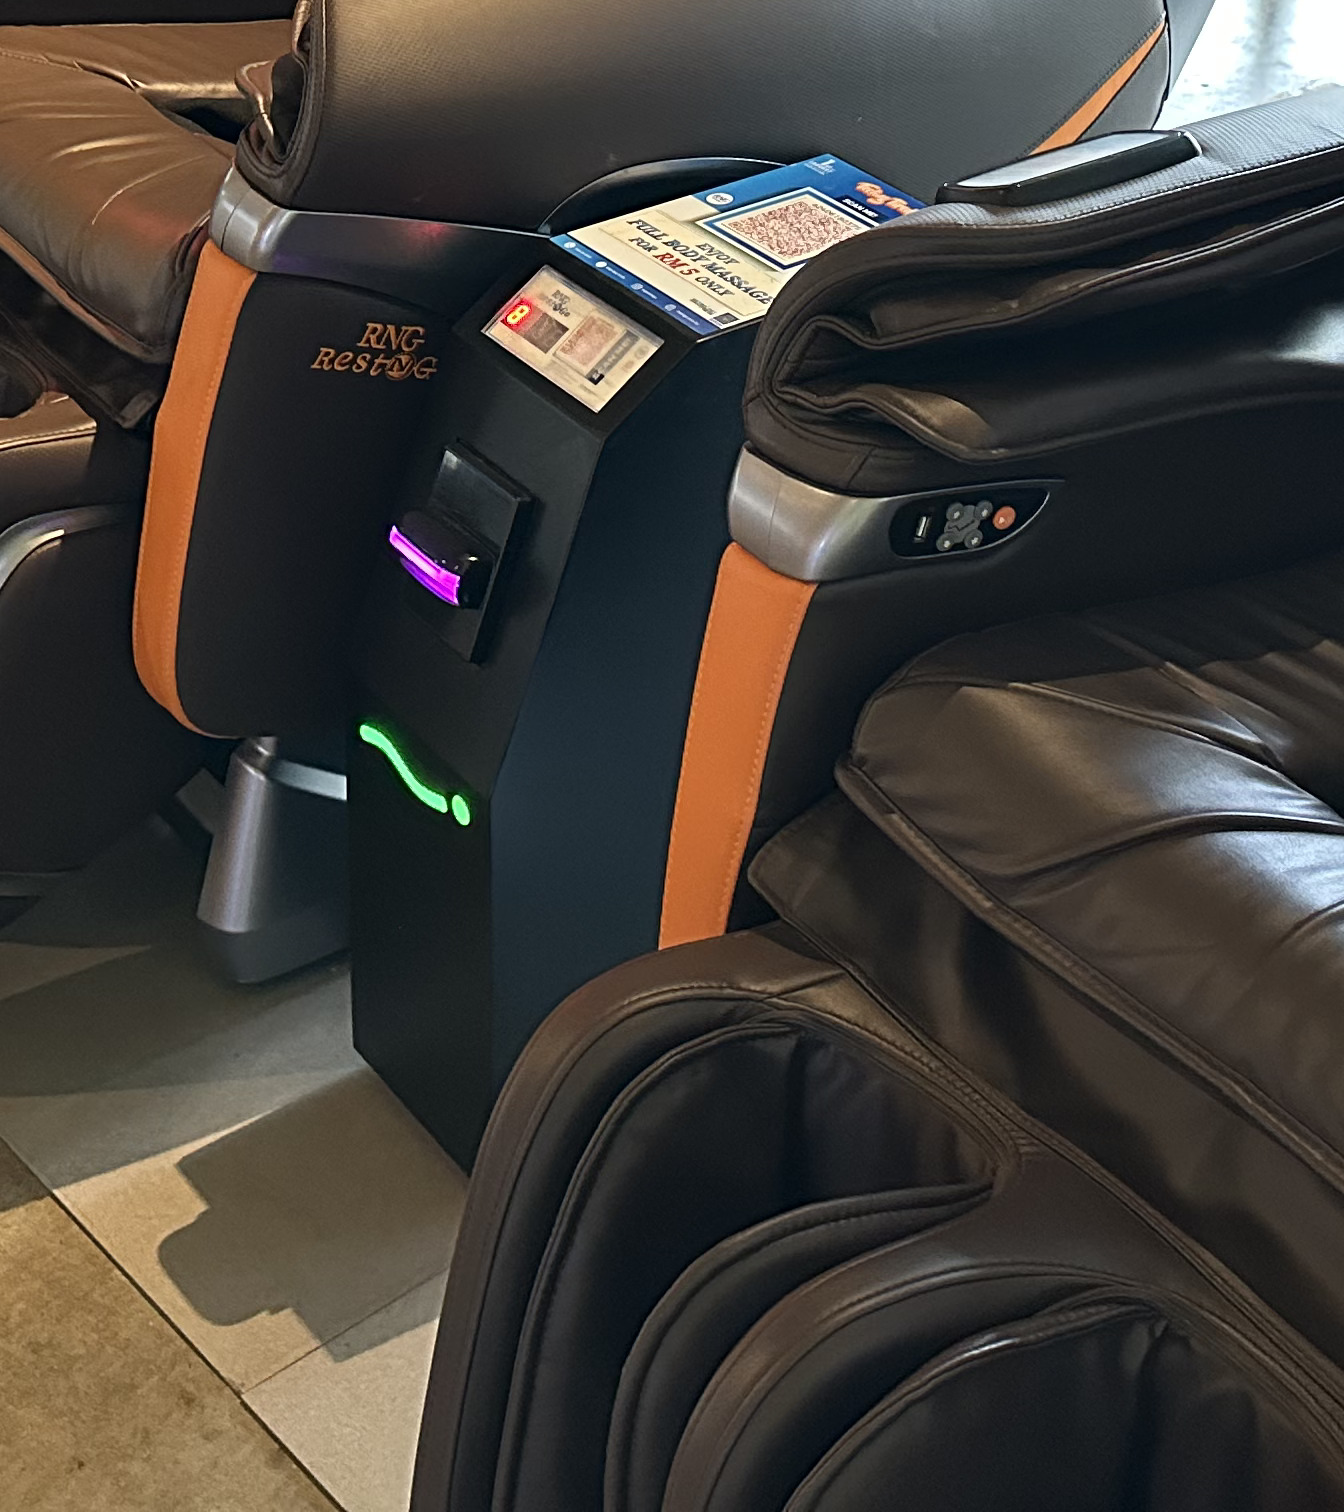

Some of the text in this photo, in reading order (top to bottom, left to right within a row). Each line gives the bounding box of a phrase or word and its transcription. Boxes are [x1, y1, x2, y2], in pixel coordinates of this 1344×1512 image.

[627, 218, 774, 305] FULL BODY MASSAGE
[628, 237, 736, 297] FOR RM 5 ONLY
[696, 242, 740, 265] ENJOY
[356, 322, 425, 352] RNG
